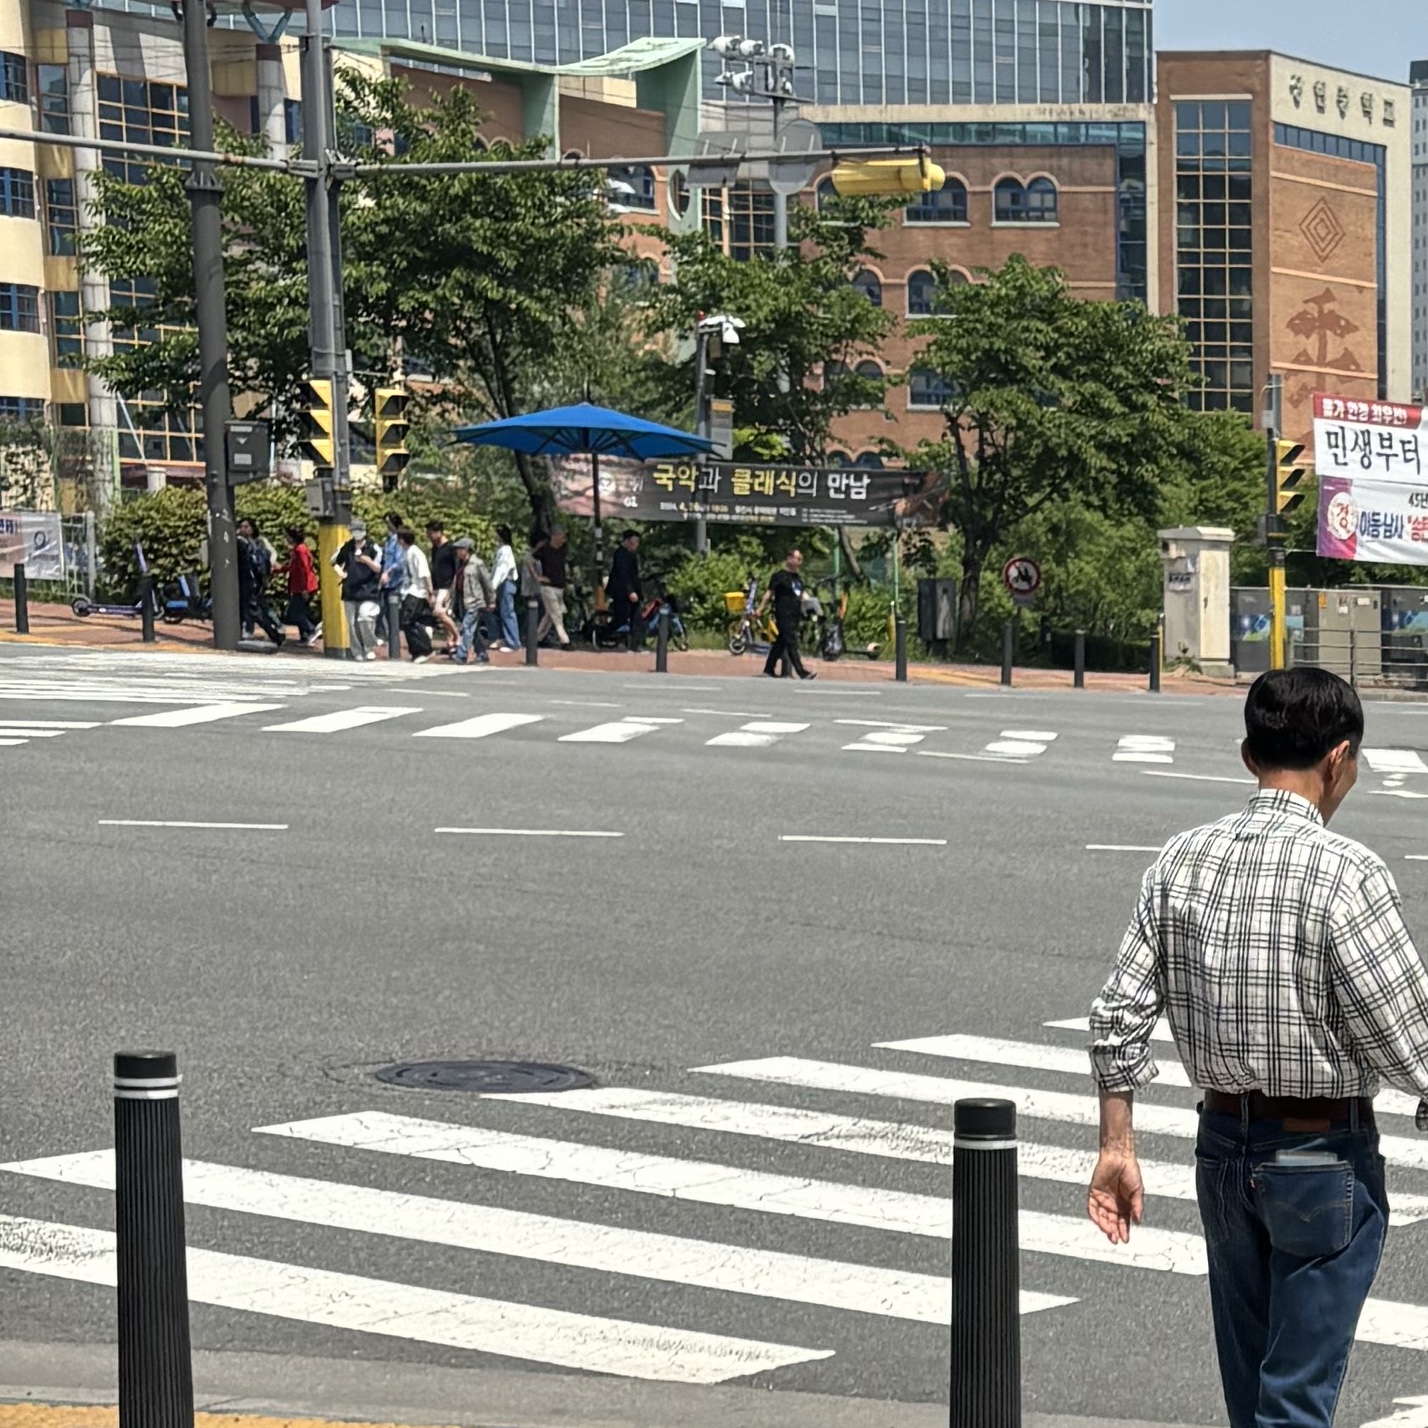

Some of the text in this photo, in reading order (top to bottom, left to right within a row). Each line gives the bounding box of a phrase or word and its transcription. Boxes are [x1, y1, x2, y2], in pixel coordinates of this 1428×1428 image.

[1325, 426, 1420, 475] 민생부터
[652, 463, 872, 500] 국악과 클래식의 만남
[1336, 502, 1350, 530] 경
